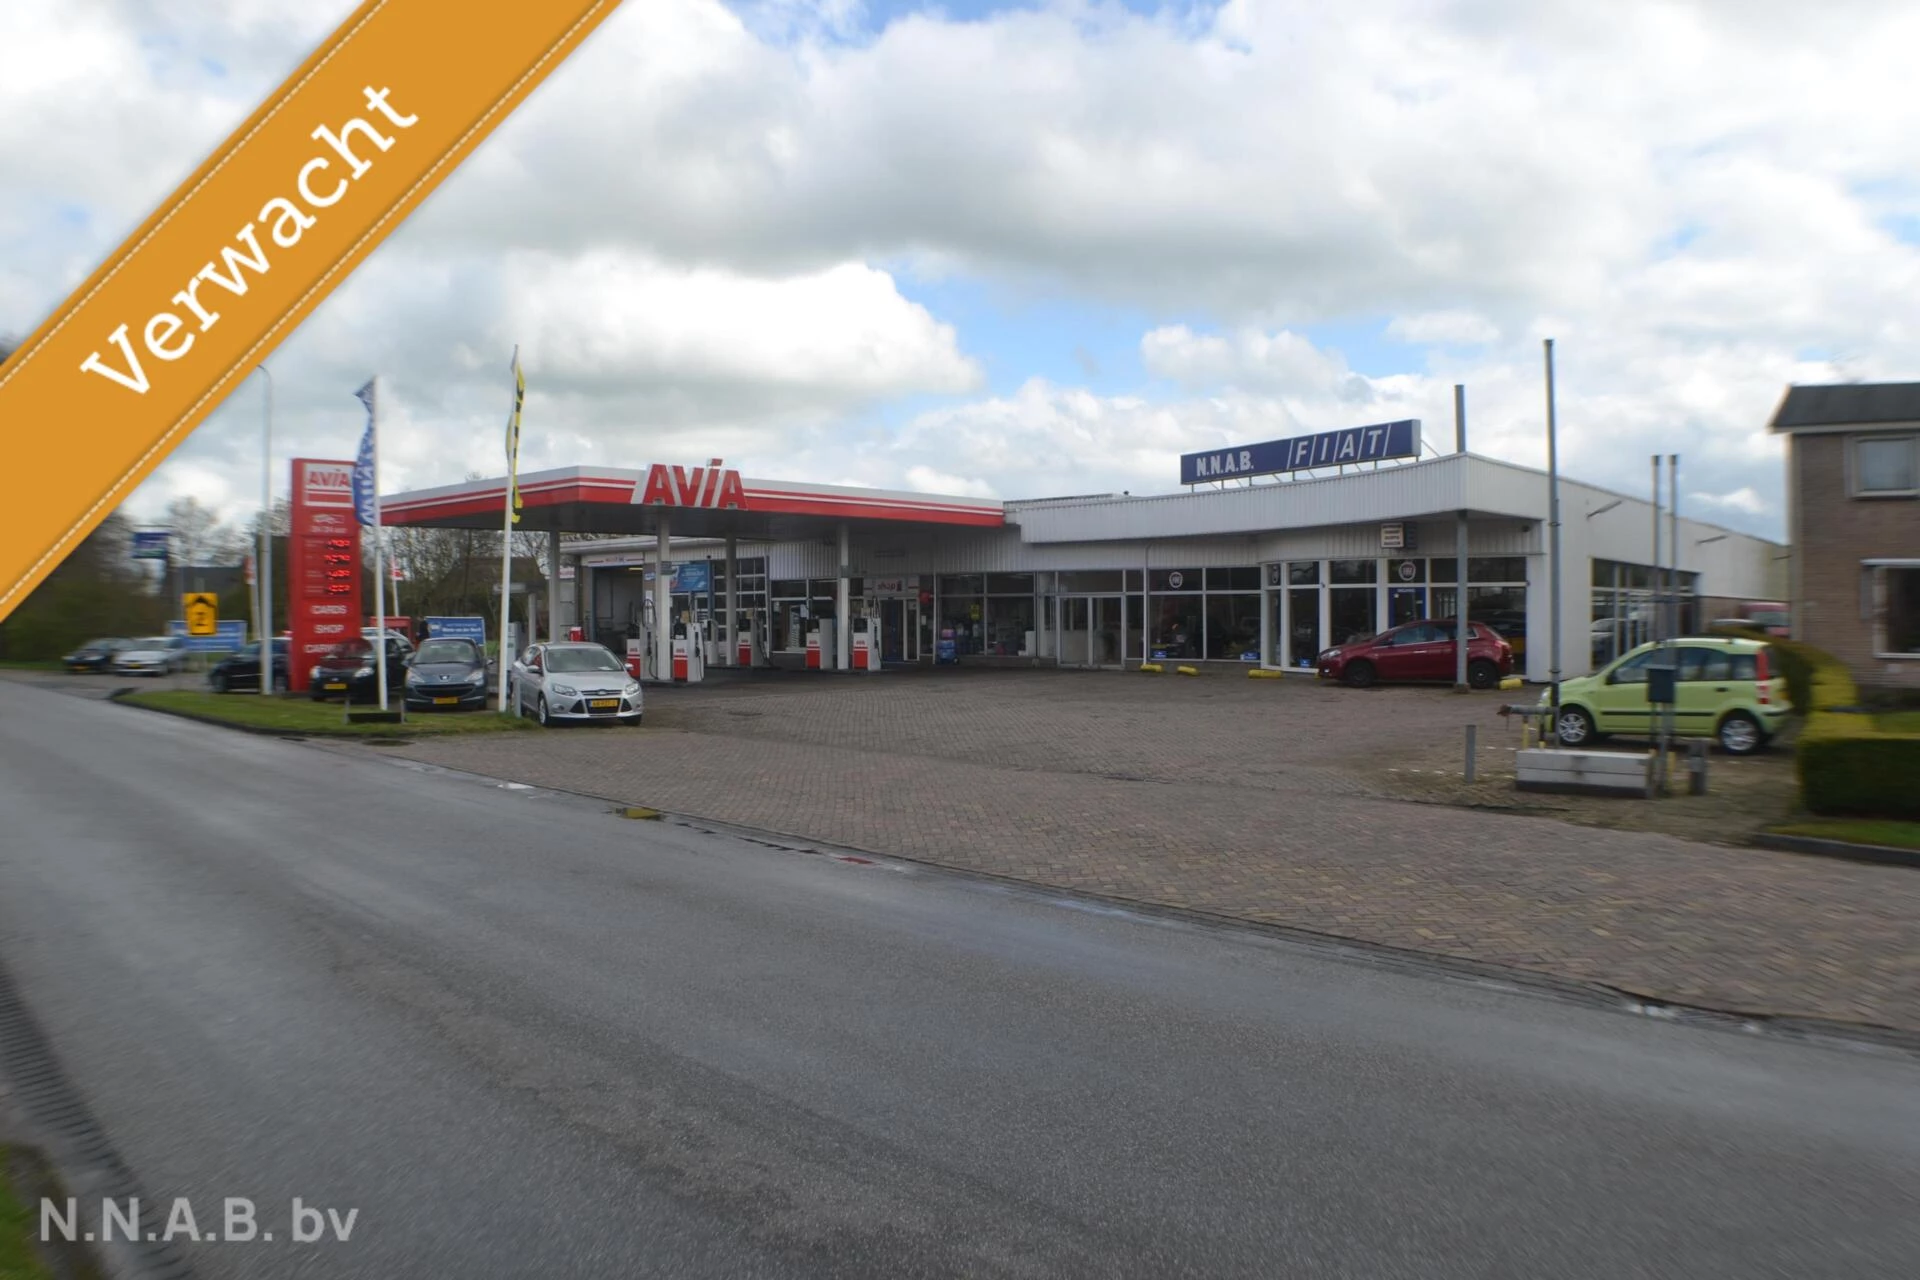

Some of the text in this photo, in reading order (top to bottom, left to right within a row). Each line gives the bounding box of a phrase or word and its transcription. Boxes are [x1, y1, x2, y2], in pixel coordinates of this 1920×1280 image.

[1196, 450, 1255, 477] N.N.A.B.
[309, 469, 350, 487] AVIA
[642, 458, 748, 511] AVIA
